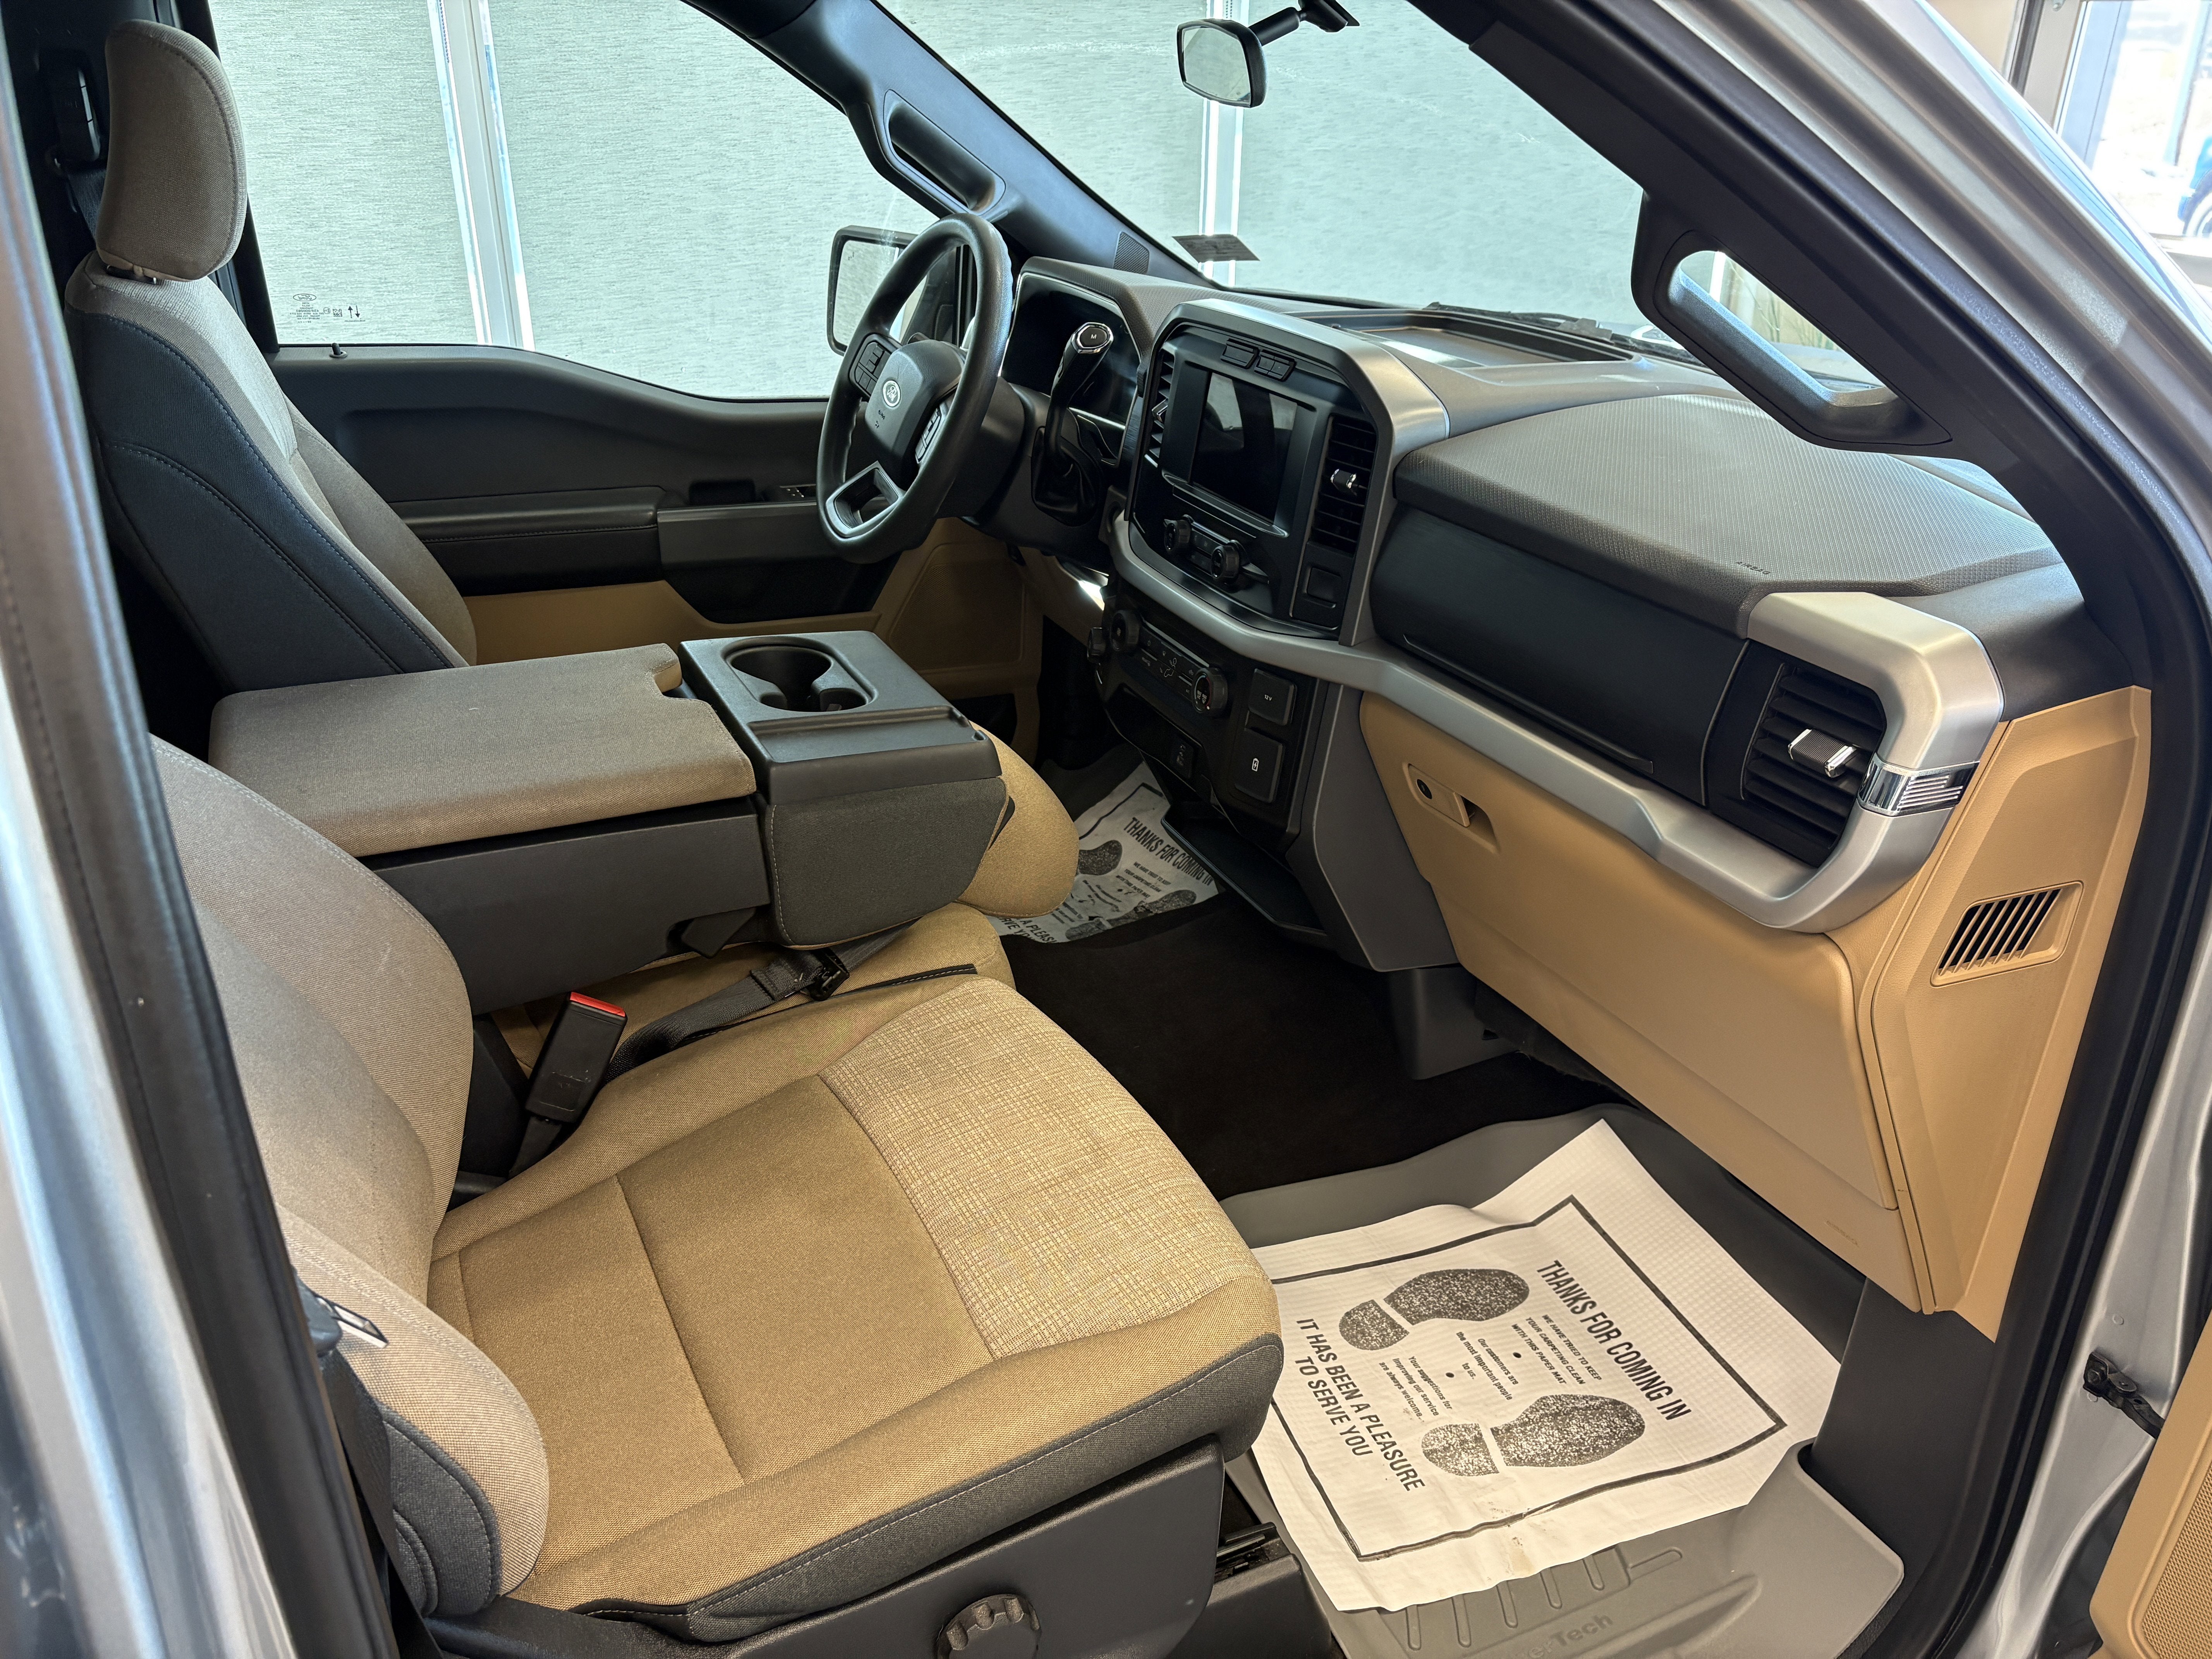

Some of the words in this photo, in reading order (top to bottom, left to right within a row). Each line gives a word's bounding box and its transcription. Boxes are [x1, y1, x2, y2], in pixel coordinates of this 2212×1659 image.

[1735, 562, 1771, 575] AIRBAG
[1124, 817, 1164, 852] THANKS
[1155, 844, 1179, 863] FOR
[1172, 853, 1205, 880] COMING
[1296, 1319, 1319, 1330] IT
[1306, 1334, 1338, 1362] HAS
[1525, 1317, 1542, 1333] YOUR
[1539, 1333, 1569, 1365] CARPETING
[1566, 1365, 1586, 1385] CLEAN
[1537, 1260, 1597, 1314] THANKS
[1580, 1312, 1622, 1344] FOR
[1606, 1342, 1673, 1401] COMING
[1657, 1399, 1692, 1420] IN
[1542, 1314, 1553, 1324] WE
[1550, 1323, 1566, 1339] HAVE
[1563, 1338, 1581, 1357] TRIED
[1578, 1356, 1589, 1365] TO
[1585, 1365, 1602, 1381] KEEP
[1379, 1362, 1389, 1371] are
[1386, 1371, 1404, 1390] always
[1456, 1331, 1467, 1341] the
[1463, 1341, 1478, 1355] most
[1474, 1354, 1499, 1382] important
[1493, 1382, 1513, 1400] people
[1462, 1362, 1469, 1370] to
[1467, 1370, 1477, 1380] us.
[1478, 1338, 1489, 1348] Our
[1486, 1348, 1511, 1376] customers
[1508, 1375, 1519, 1385] are
[1511, 1324, 1528, 1338] WITH
[1524, 1338, 1539, 1352] THIS
[1536, 1352, 1555, 1371] PAPER
[1552, 1370, 1567, 1385] MAT
[1295, 1356, 1319, 1376] TO
[1307, 1379, 1351, 1425] SERVE
[1339, 1425, 1373, 1456] YOU
[1325, 1365, 1364, 1401] BEEN
[1350, 1403, 1371, 1413] A
[1392, 1358, 1417, 1385] improving
[1413, 1384, 1424, 1393] our
[1421, 1393, 1439, 1416] service
[1408, 1356, 1421, 1369] Your
[1417, 1369, 1446, 1400] suggestions
[1443, 1400, 1453, 1410] for
[1360, 1414, 1425, 1491] PLEASURE
[1525, 1615, 1613, 1659] erTech
